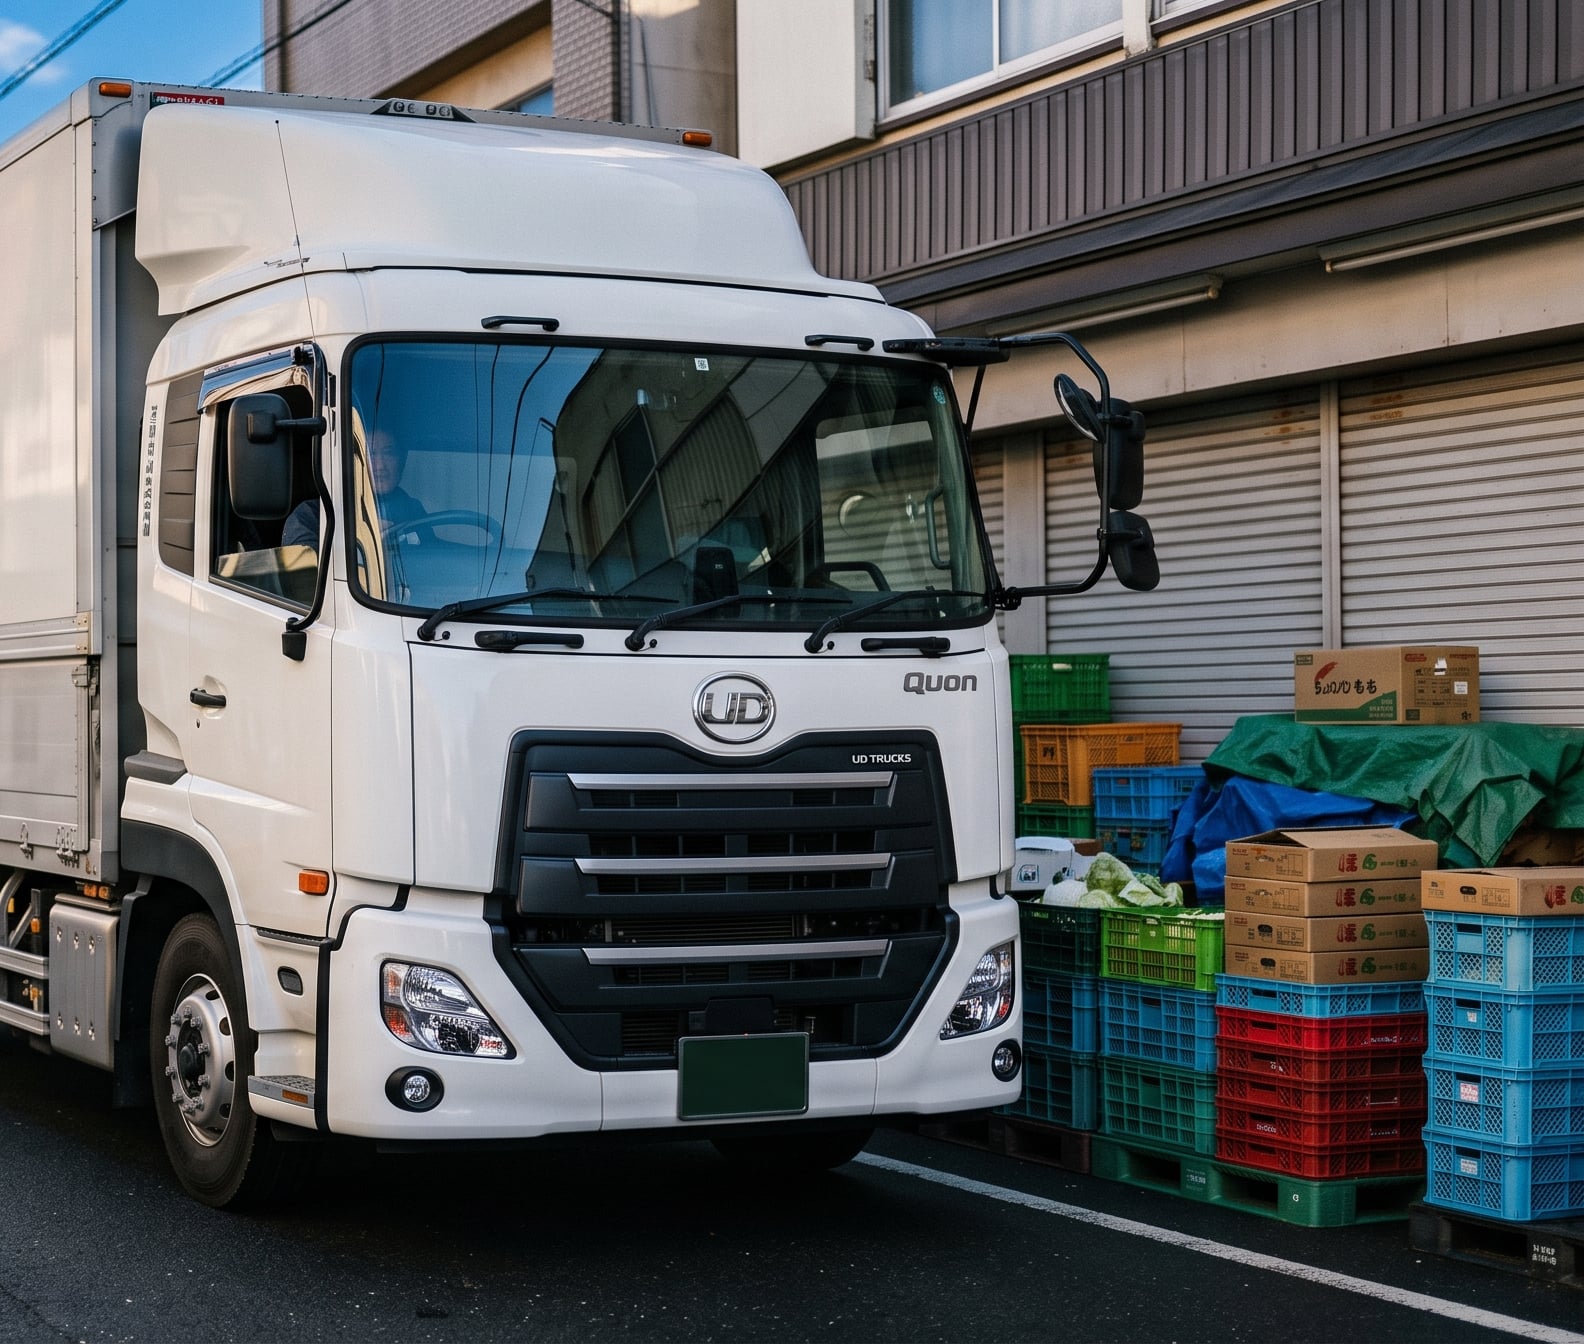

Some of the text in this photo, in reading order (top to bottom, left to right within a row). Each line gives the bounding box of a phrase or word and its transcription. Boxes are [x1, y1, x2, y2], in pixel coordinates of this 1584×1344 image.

[903, 672, 977, 695] Quon
[702, 692, 770, 725] UD
[852, 753, 912, 764] UD TRUCKS
